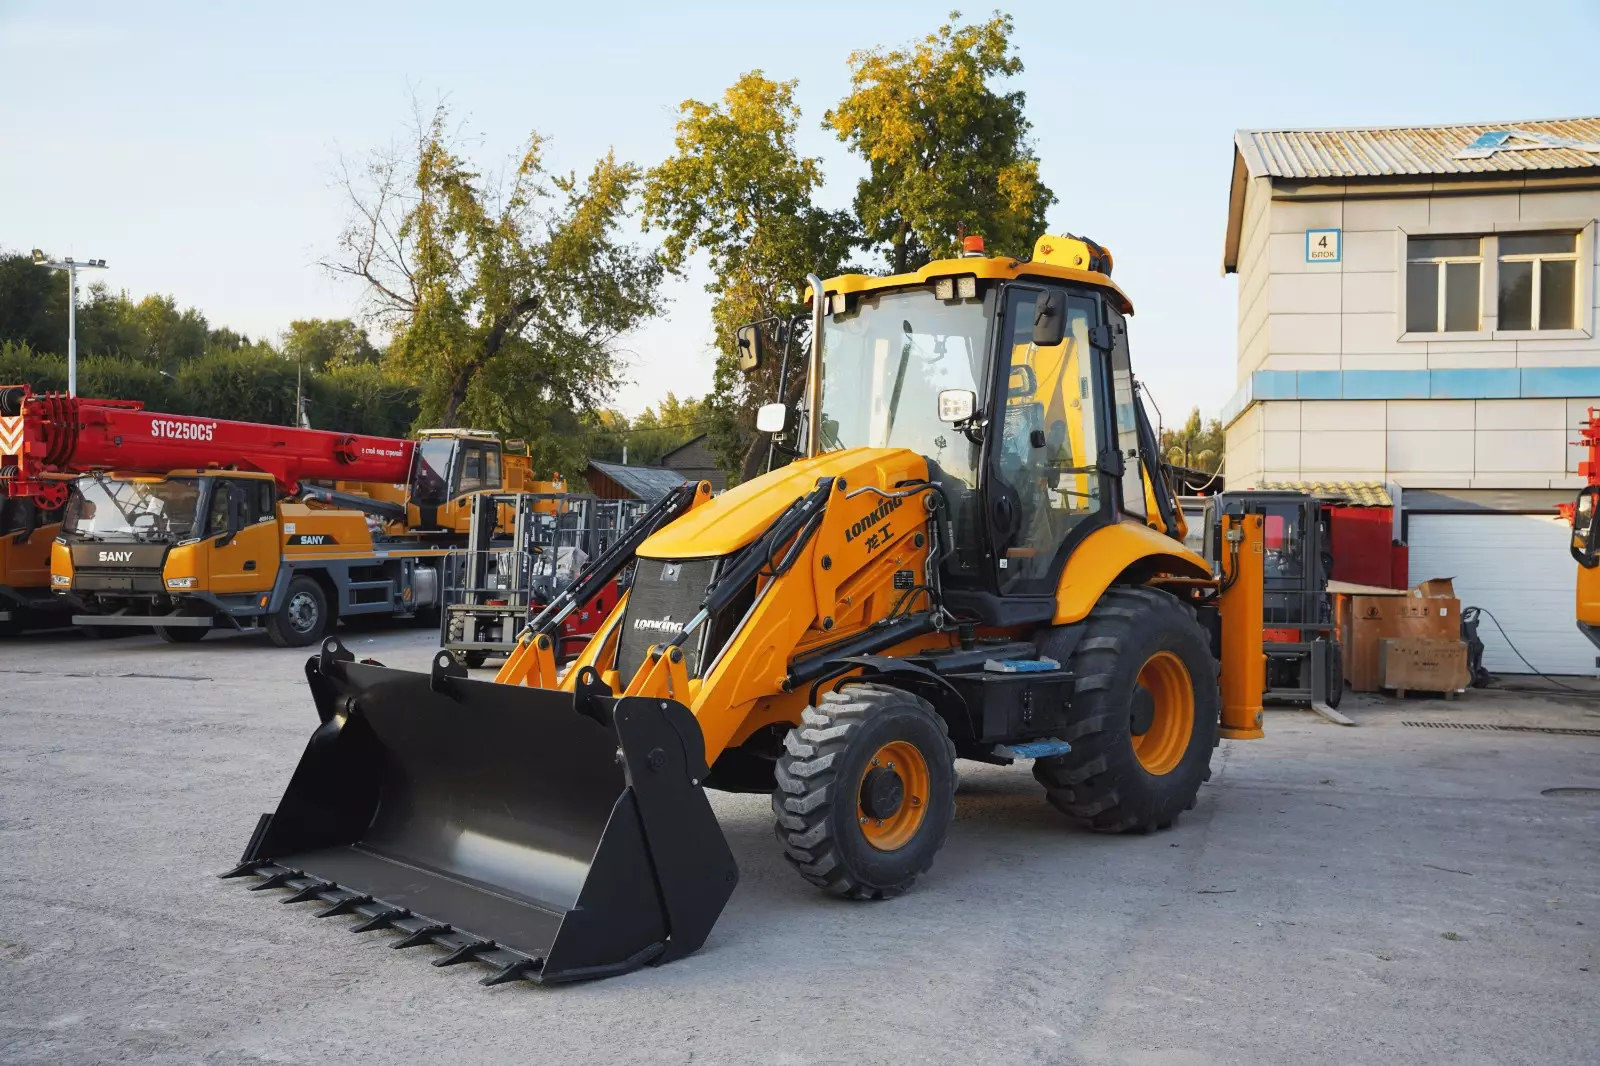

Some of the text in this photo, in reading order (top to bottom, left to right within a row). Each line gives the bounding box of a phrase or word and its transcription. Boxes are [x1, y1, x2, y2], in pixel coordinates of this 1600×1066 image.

[1318, 235, 1328, 249] 4
[1311, 251, 1335, 259] БЛОК
[300, 535, 324, 545] SANY
[98, 551, 133, 562] SANY
